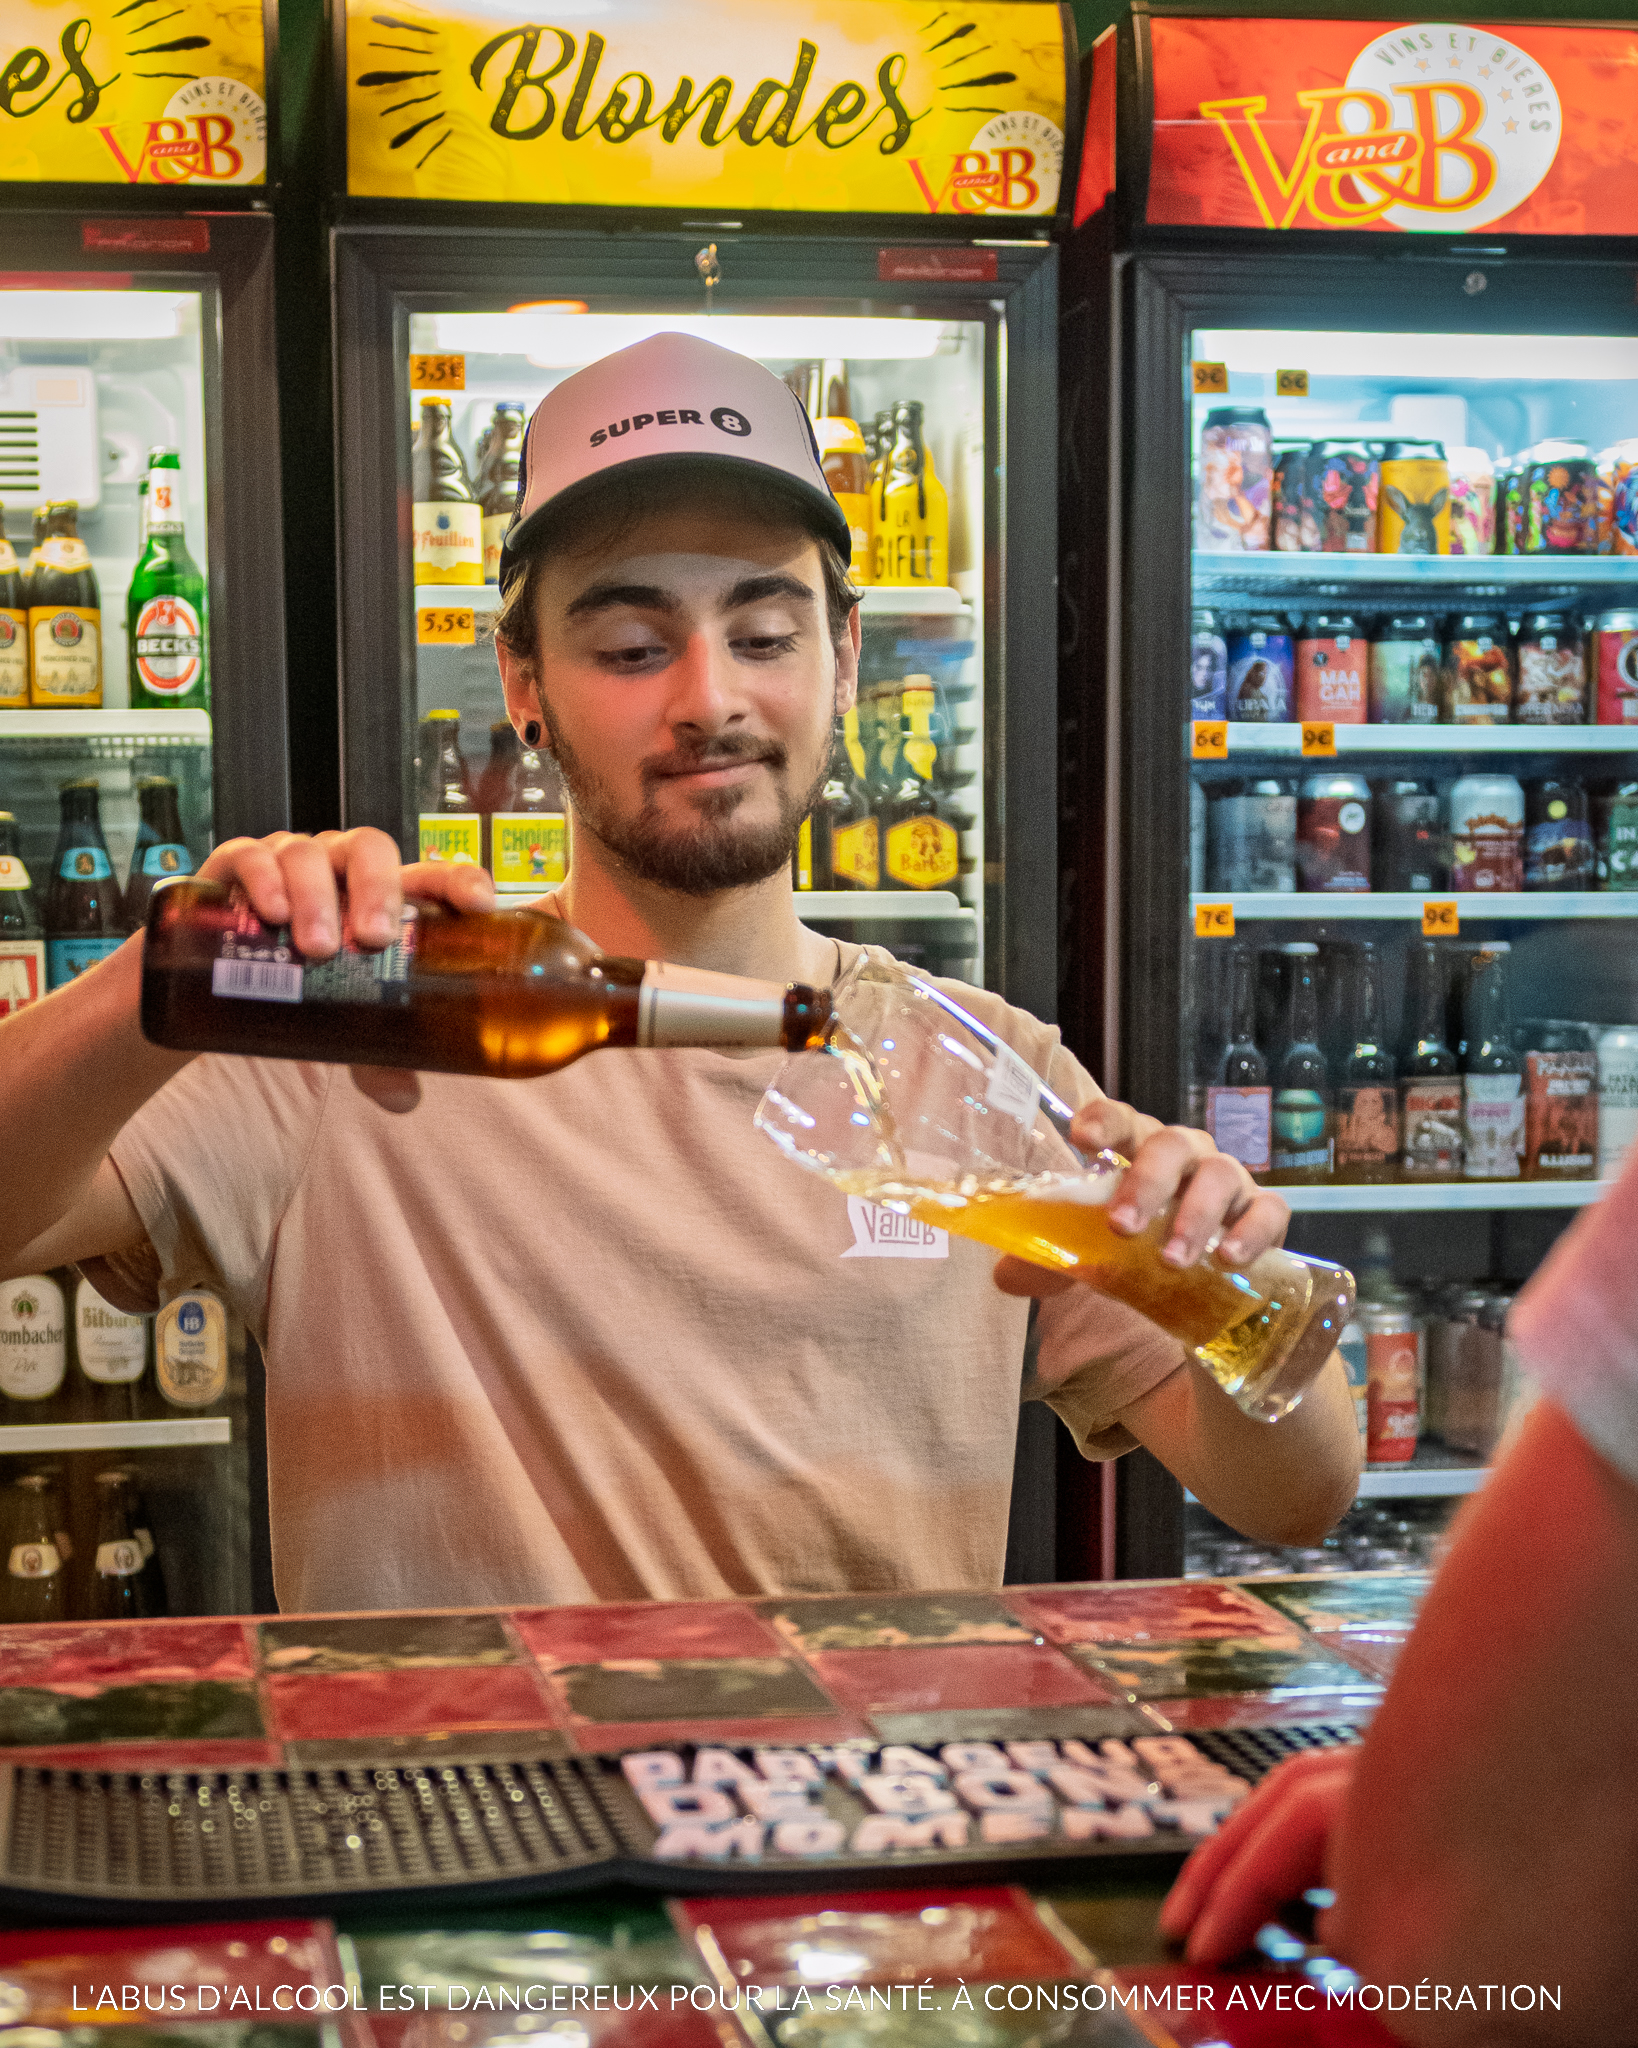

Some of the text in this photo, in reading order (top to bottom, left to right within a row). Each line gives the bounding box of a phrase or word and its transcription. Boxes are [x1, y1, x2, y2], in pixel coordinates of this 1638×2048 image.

[470, 24, 932, 155] Blondes
[1374, 33, 1552, 132] VINS ET BIERES
[1326, 136, 1405, 165] and
[416, 362, 463, 382] 5,5€
[589, 409, 705, 448] SUPER
[424, 612, 472, 632] 5,5€
[1195, 729, 1225, 748] 6€
[1304, 729, 1333, 748] 9€
[1202, 910, 1230, 929] 7€
[1426, 907, 1453, 928] 9€
